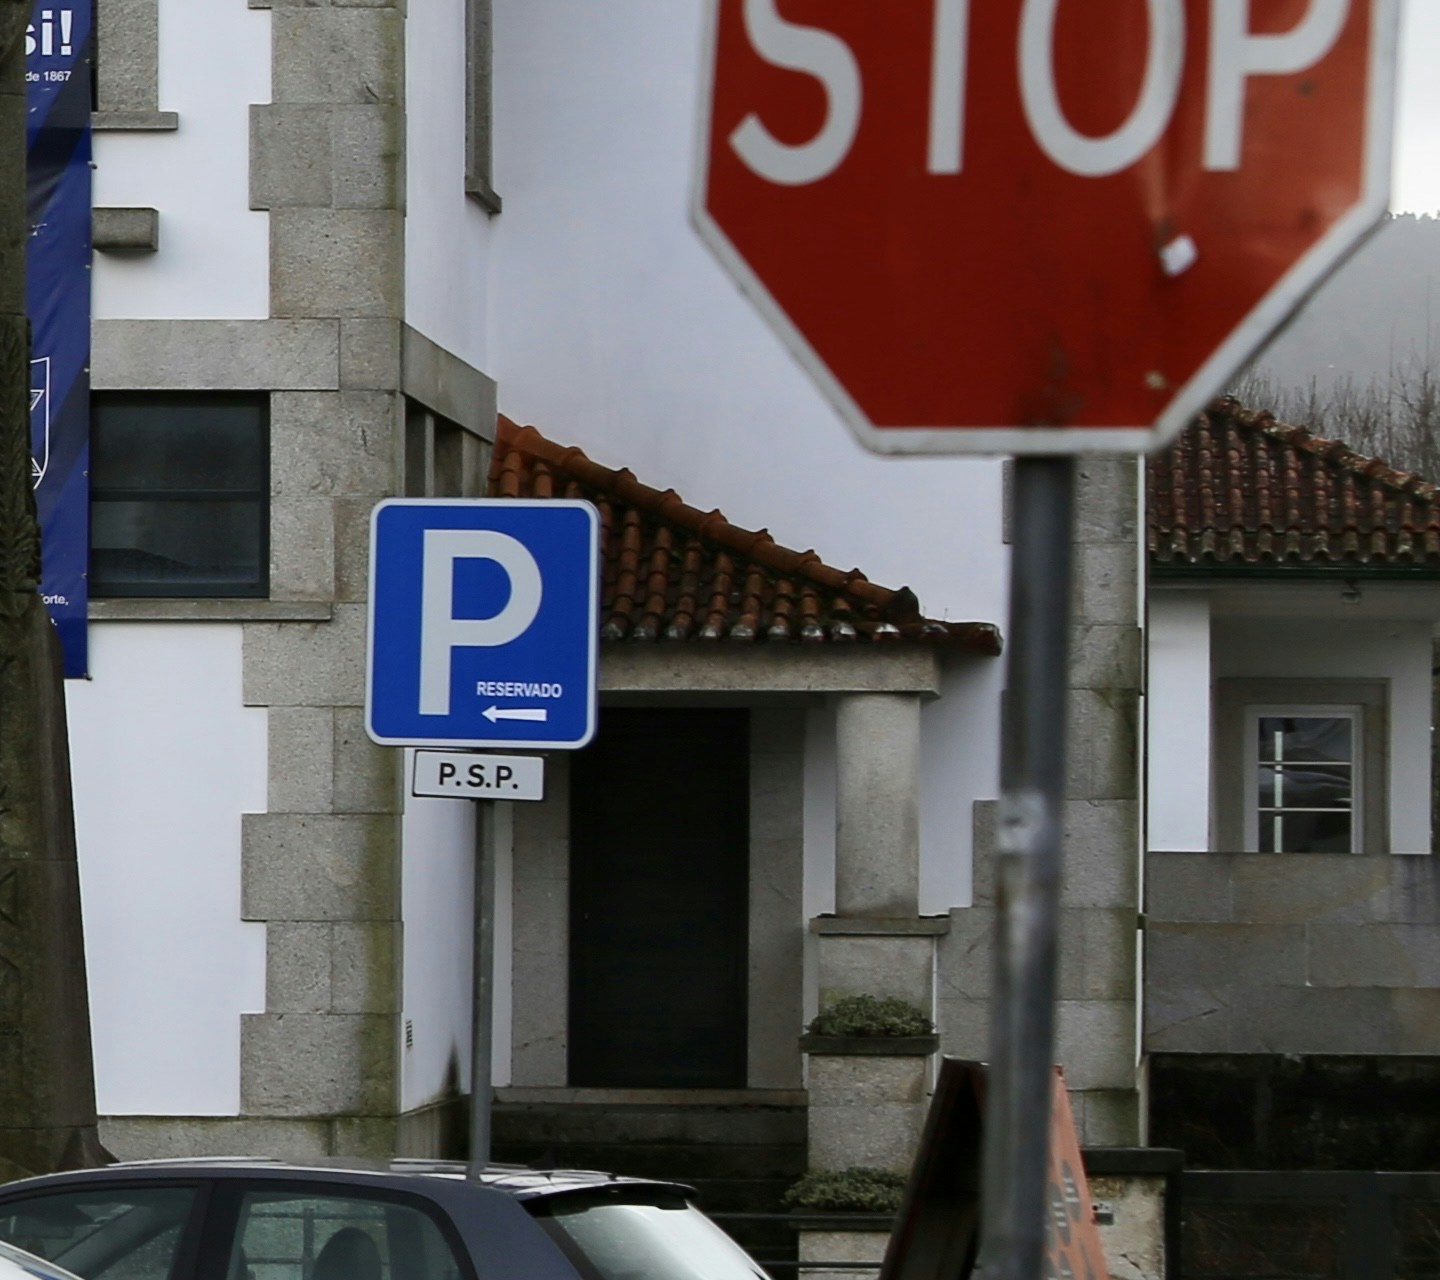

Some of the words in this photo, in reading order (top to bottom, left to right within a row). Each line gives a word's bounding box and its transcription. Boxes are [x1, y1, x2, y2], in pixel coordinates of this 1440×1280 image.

[43, 70, 72, 82] 1867
[418, 529, 543, 716] P
[476, 680, 563, 699] RESERVADO
[438, 762, 519, 791] P.S.P.
